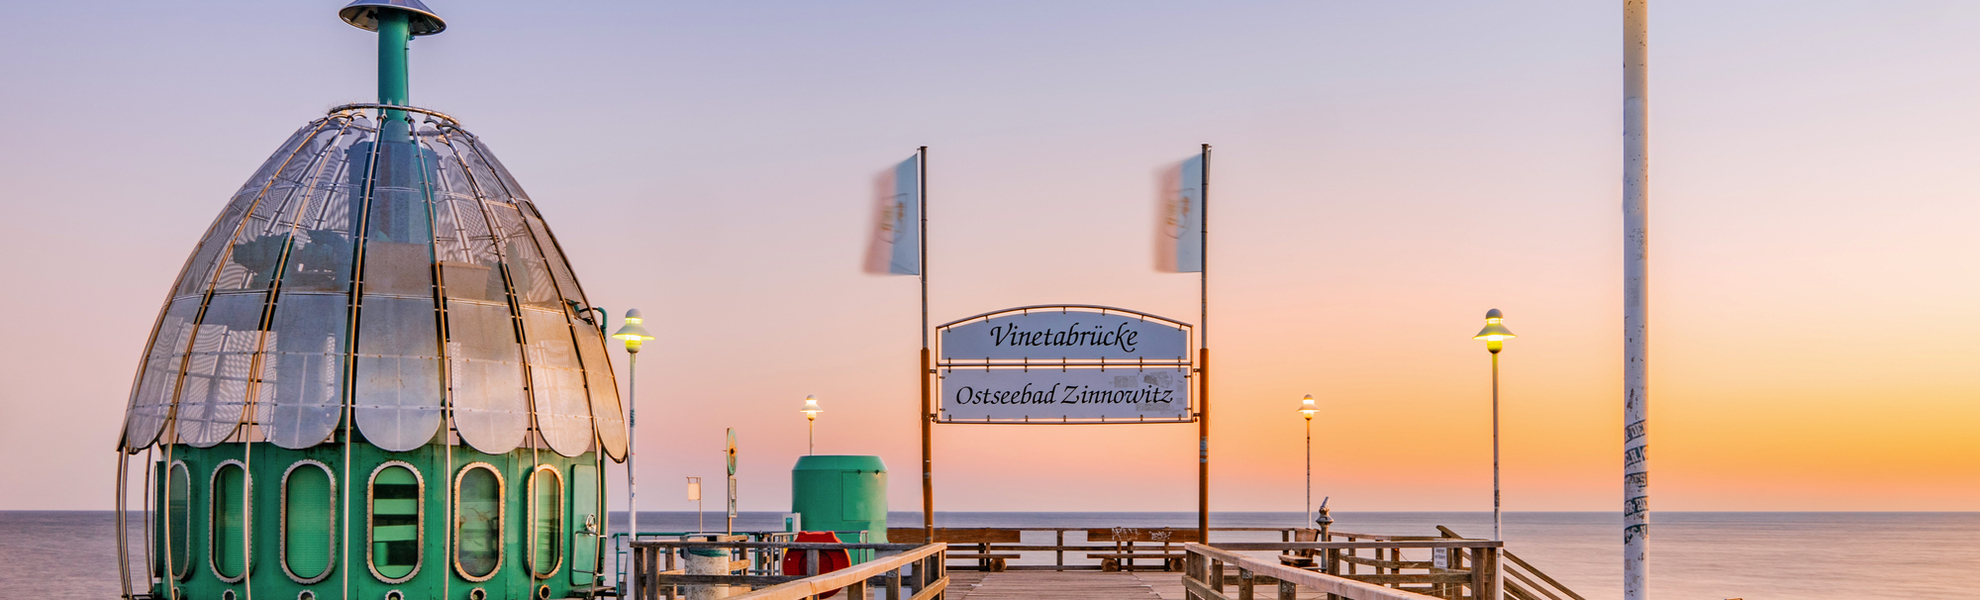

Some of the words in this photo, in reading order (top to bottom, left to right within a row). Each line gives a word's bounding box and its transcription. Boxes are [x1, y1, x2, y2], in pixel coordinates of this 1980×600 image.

[989, 321, 1139, 353] Vinetabrücke
[956, 382, 1060, 405] Ostseebad
[1060, 384, 1174, 404] Zinnowitz
